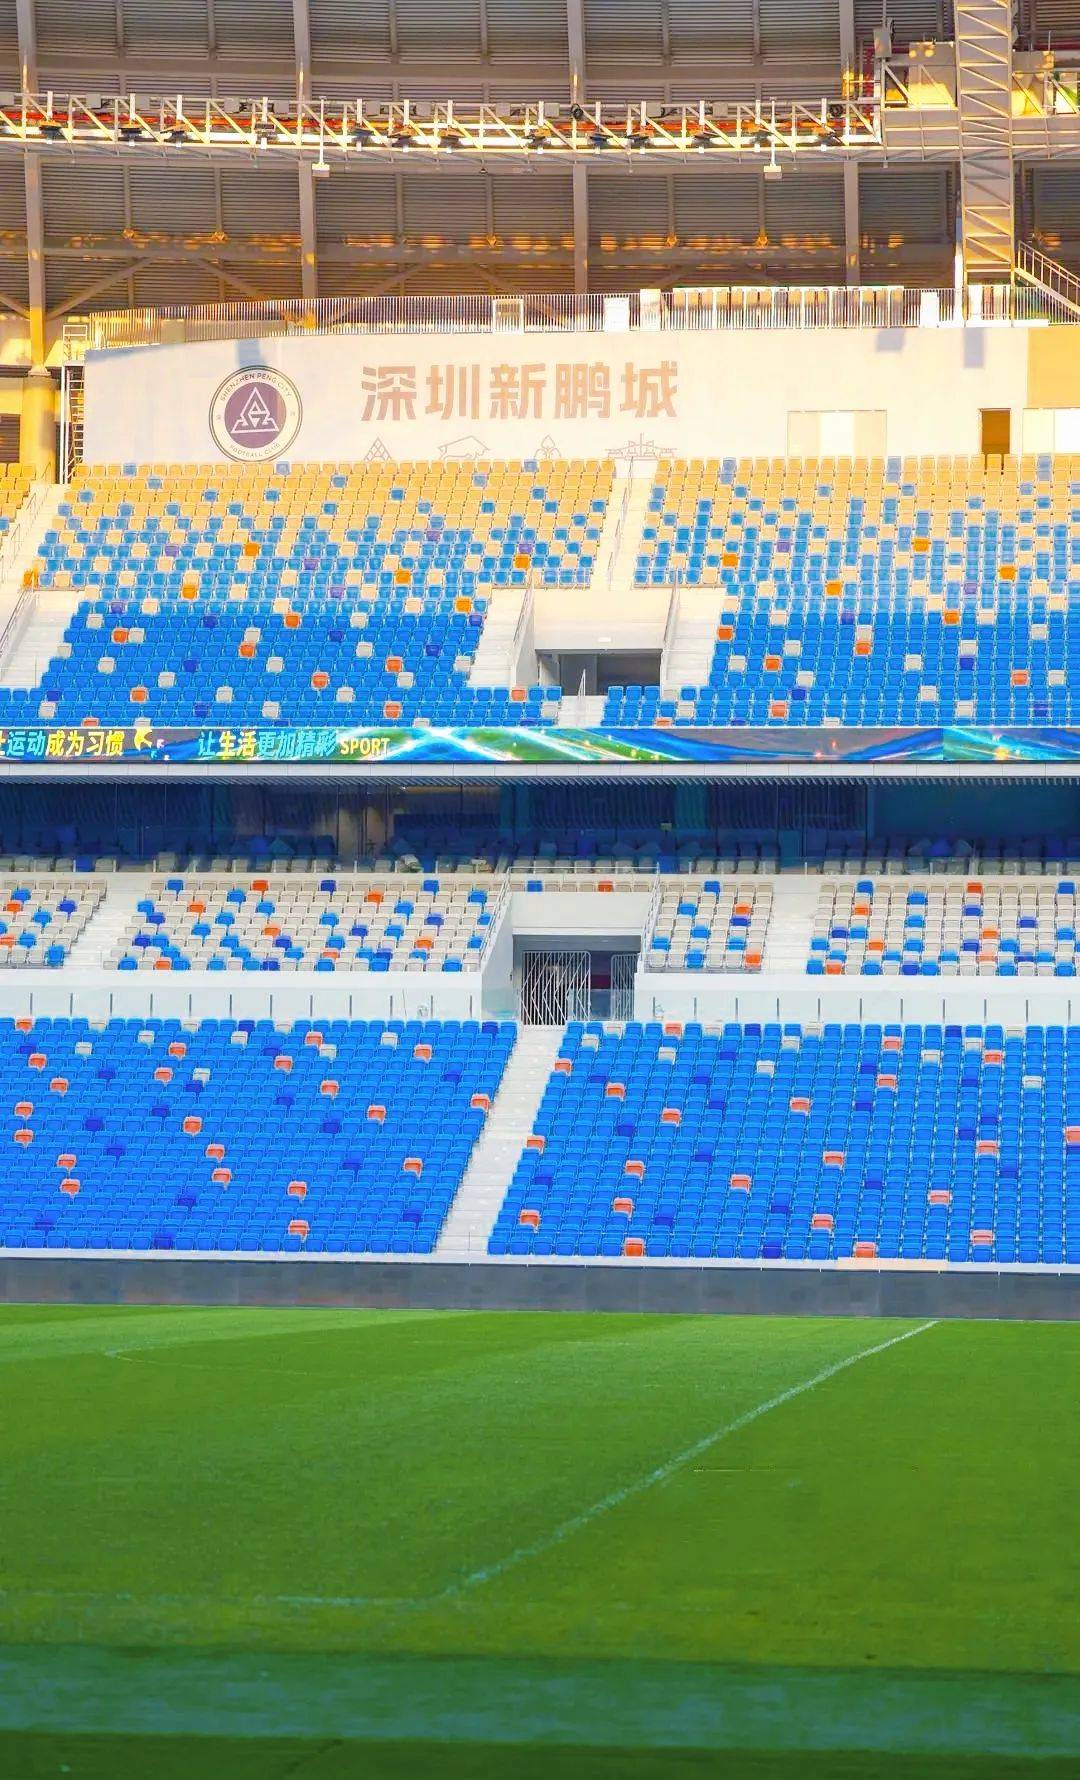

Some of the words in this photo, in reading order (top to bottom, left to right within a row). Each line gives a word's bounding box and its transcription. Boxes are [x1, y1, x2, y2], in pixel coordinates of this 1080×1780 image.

[220, 372, 255, 401] SHENZHEN
[256, 372, 277, 384] PENG
[361, 361, 678, 421] 深圳新鹏城
[198, 730, 337, 758] 让生活更加精彩
[339, 737, 391, 755] SPORT
